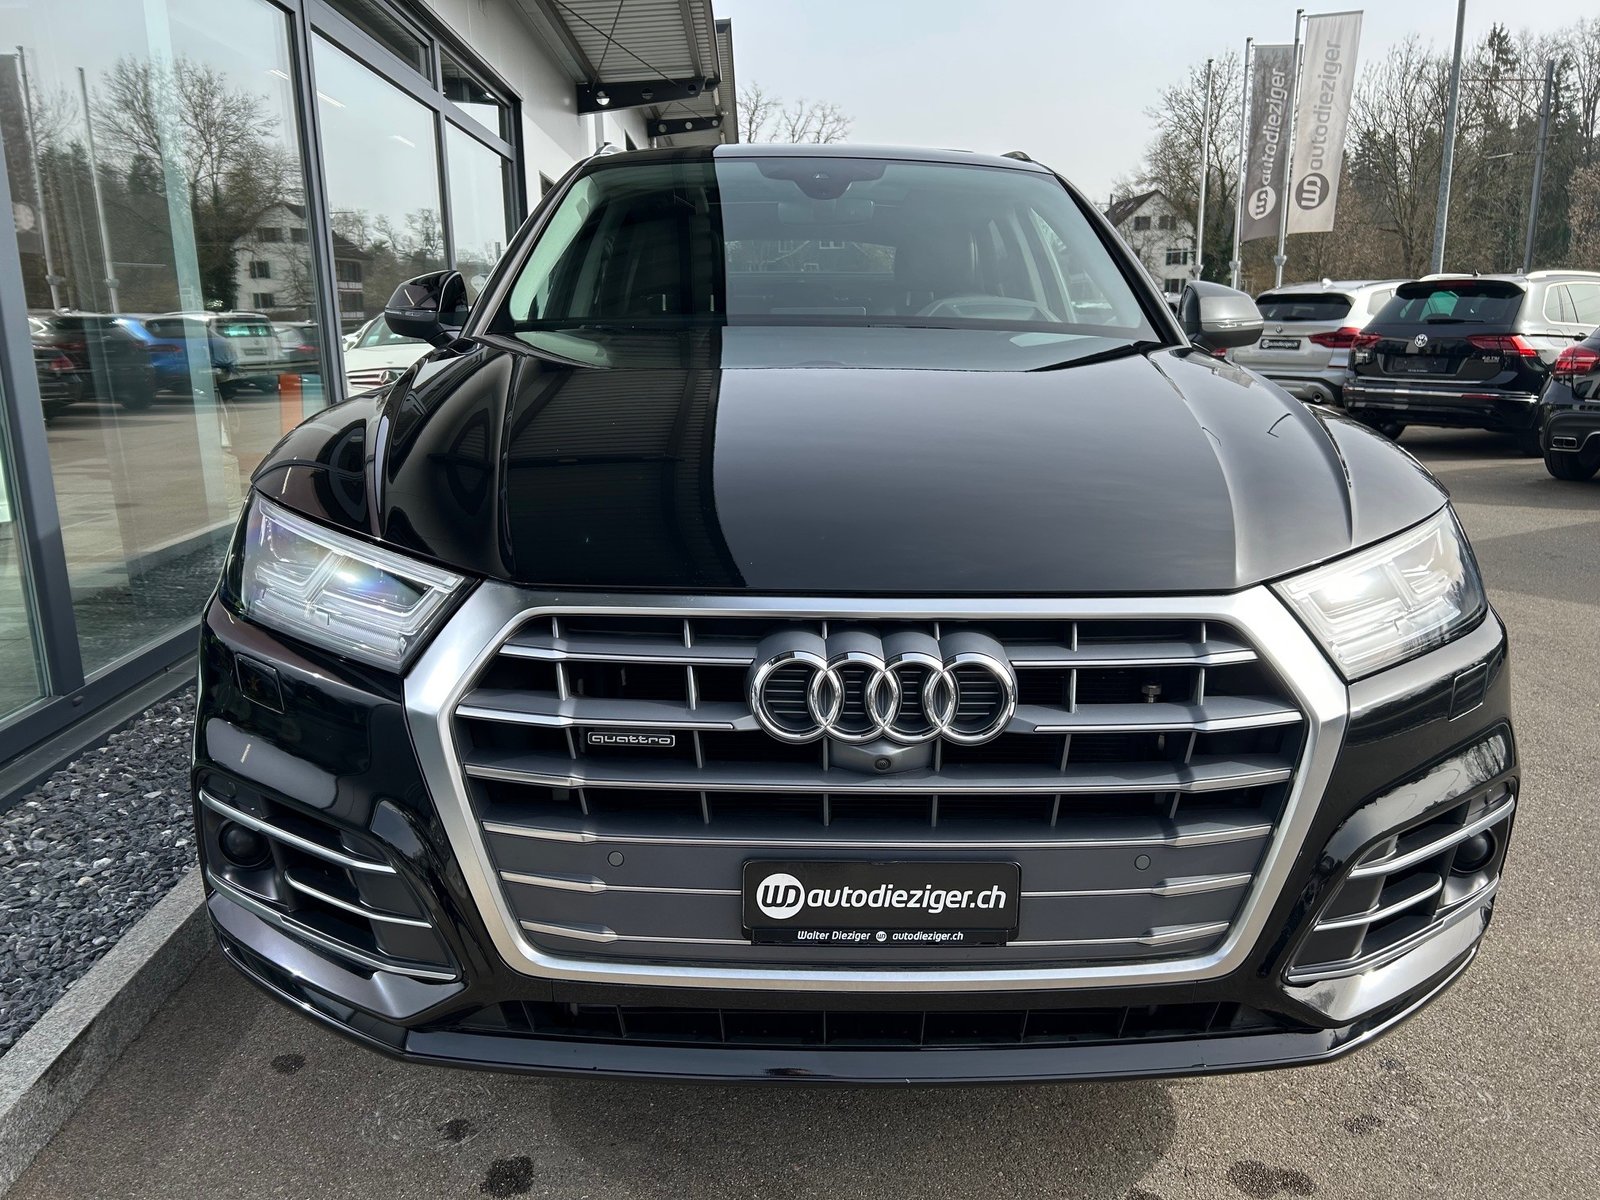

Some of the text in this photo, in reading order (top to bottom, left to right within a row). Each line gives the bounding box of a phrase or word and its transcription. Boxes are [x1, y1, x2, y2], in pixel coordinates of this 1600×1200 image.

[1309, 40, 1342, 171] autodieziger
[1261, 68, 1288, 186] autodieziger
[592, 735, 671, 744] quattro
[807, 884, 1007, 914] autodieziger.ch
[797, 931, 829, 940] Walter
[831, 931, 871, 942] Dieziger
[892, 931, 964, 942] autodieziger.ch
